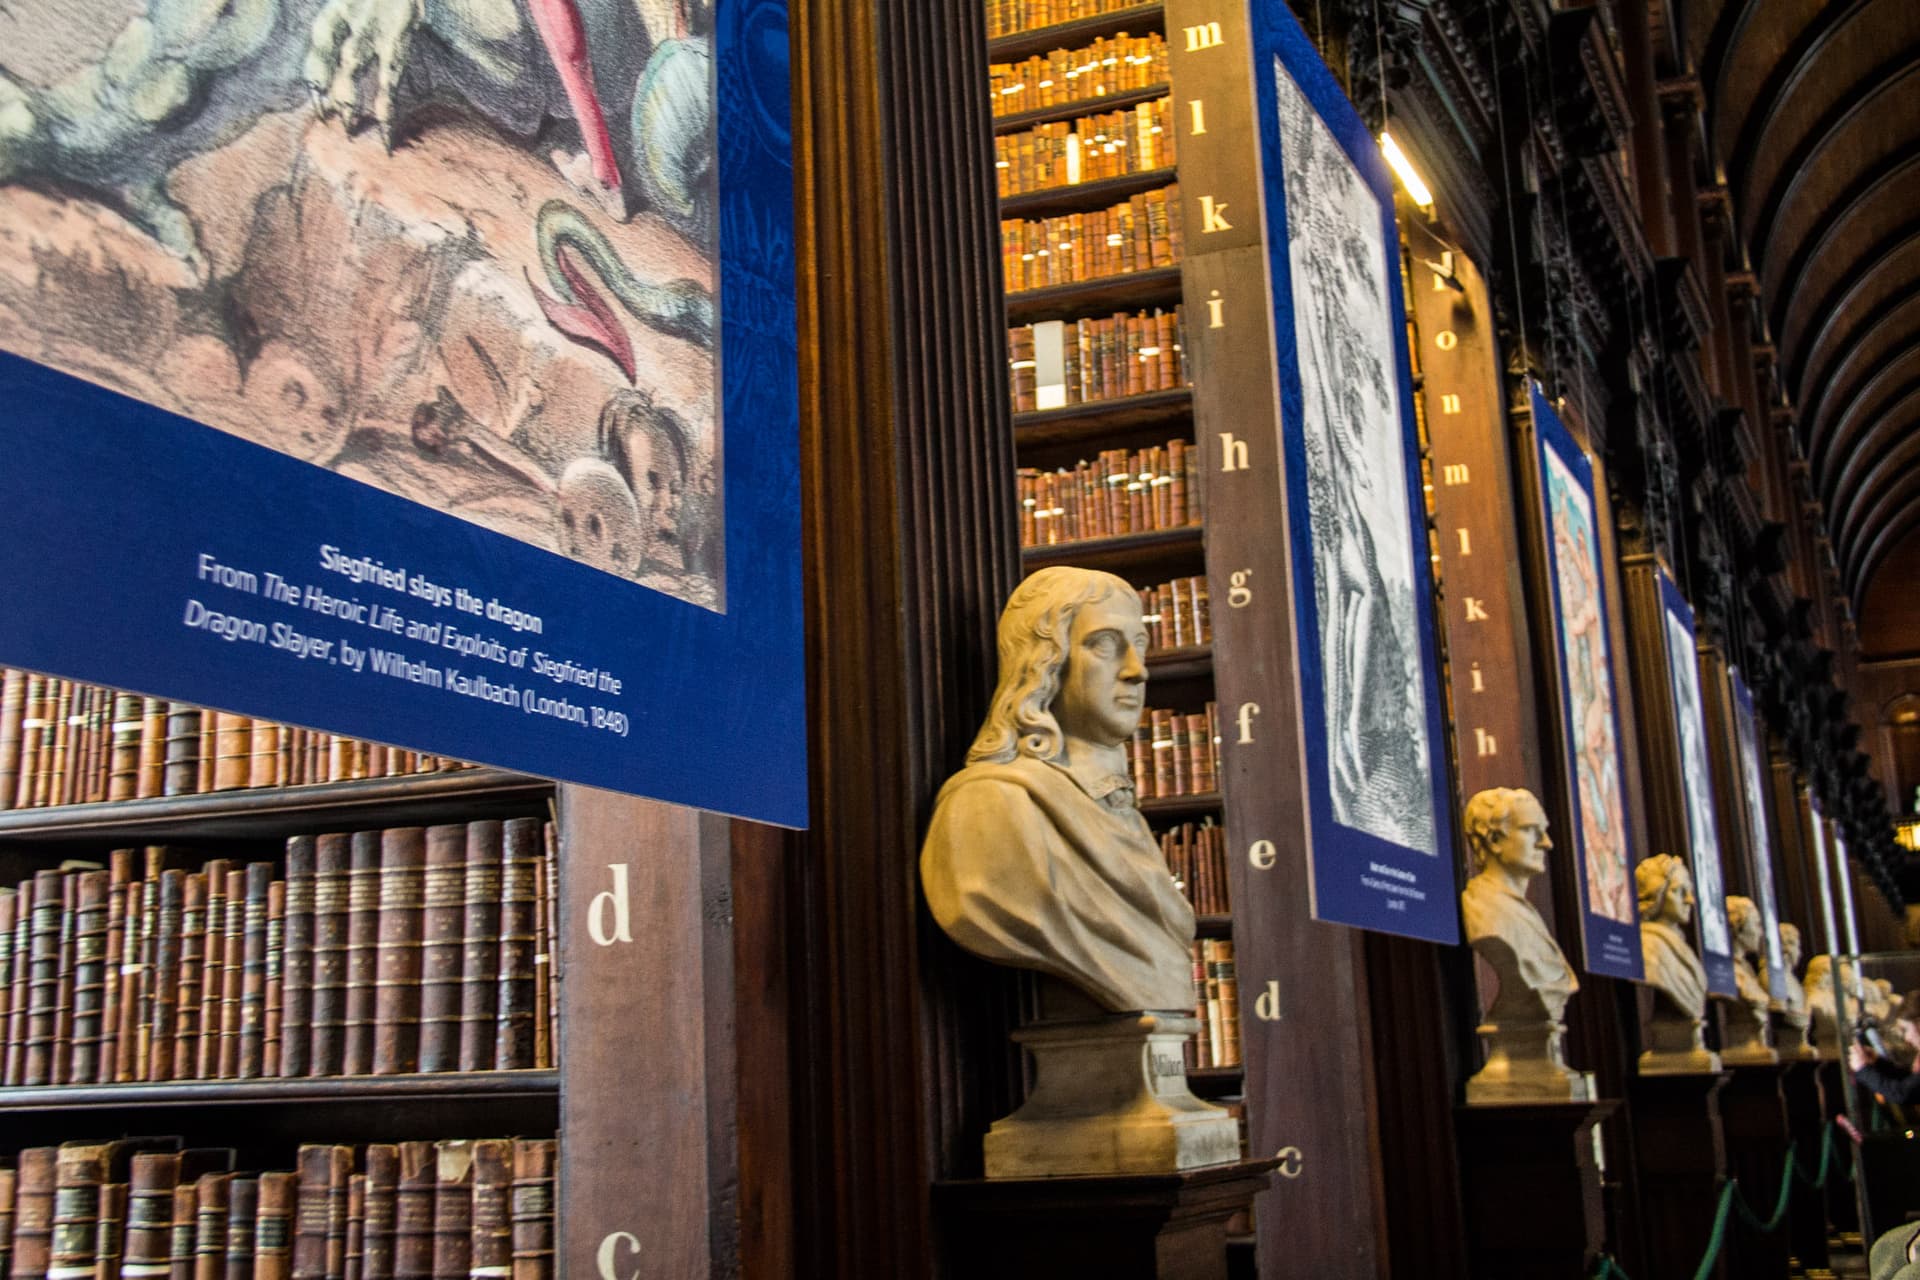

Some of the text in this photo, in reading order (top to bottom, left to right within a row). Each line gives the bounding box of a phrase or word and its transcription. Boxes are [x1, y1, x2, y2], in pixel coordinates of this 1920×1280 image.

[1183, 20, 1225, 52] m
[1197, 194, 1234, 233] k
[1206, 289, 1224, 329] i
[1434, 330, 1457, 351] o
[1441, 394, 1462, 415] n
[1218, 432, 1250, 472] h
[1443, 462, 1470, 486] m
[319, 544, 543, 634] Siegfried slays the dragon
[1227, 568, 1253, 609] g
[199, 553, 622, 695] From The Heroic Life and Exploits of Siegfried the
[1464, 596, 1489, 622] k
[183, 599, 629, 737] Dragon Slayer, by Wilhelm Kaulbach (London, 1848)
[1470, 661, 1485, 693] i
[1235, 702, 1261, 745] f
[1475, 727, 1498, 757] h
[1248, 839, 1276, 871] e
[587, 863, 634, 947] d
[1254, 980, 1281, 1021] d
[596, 1231, 642, 1280] c
